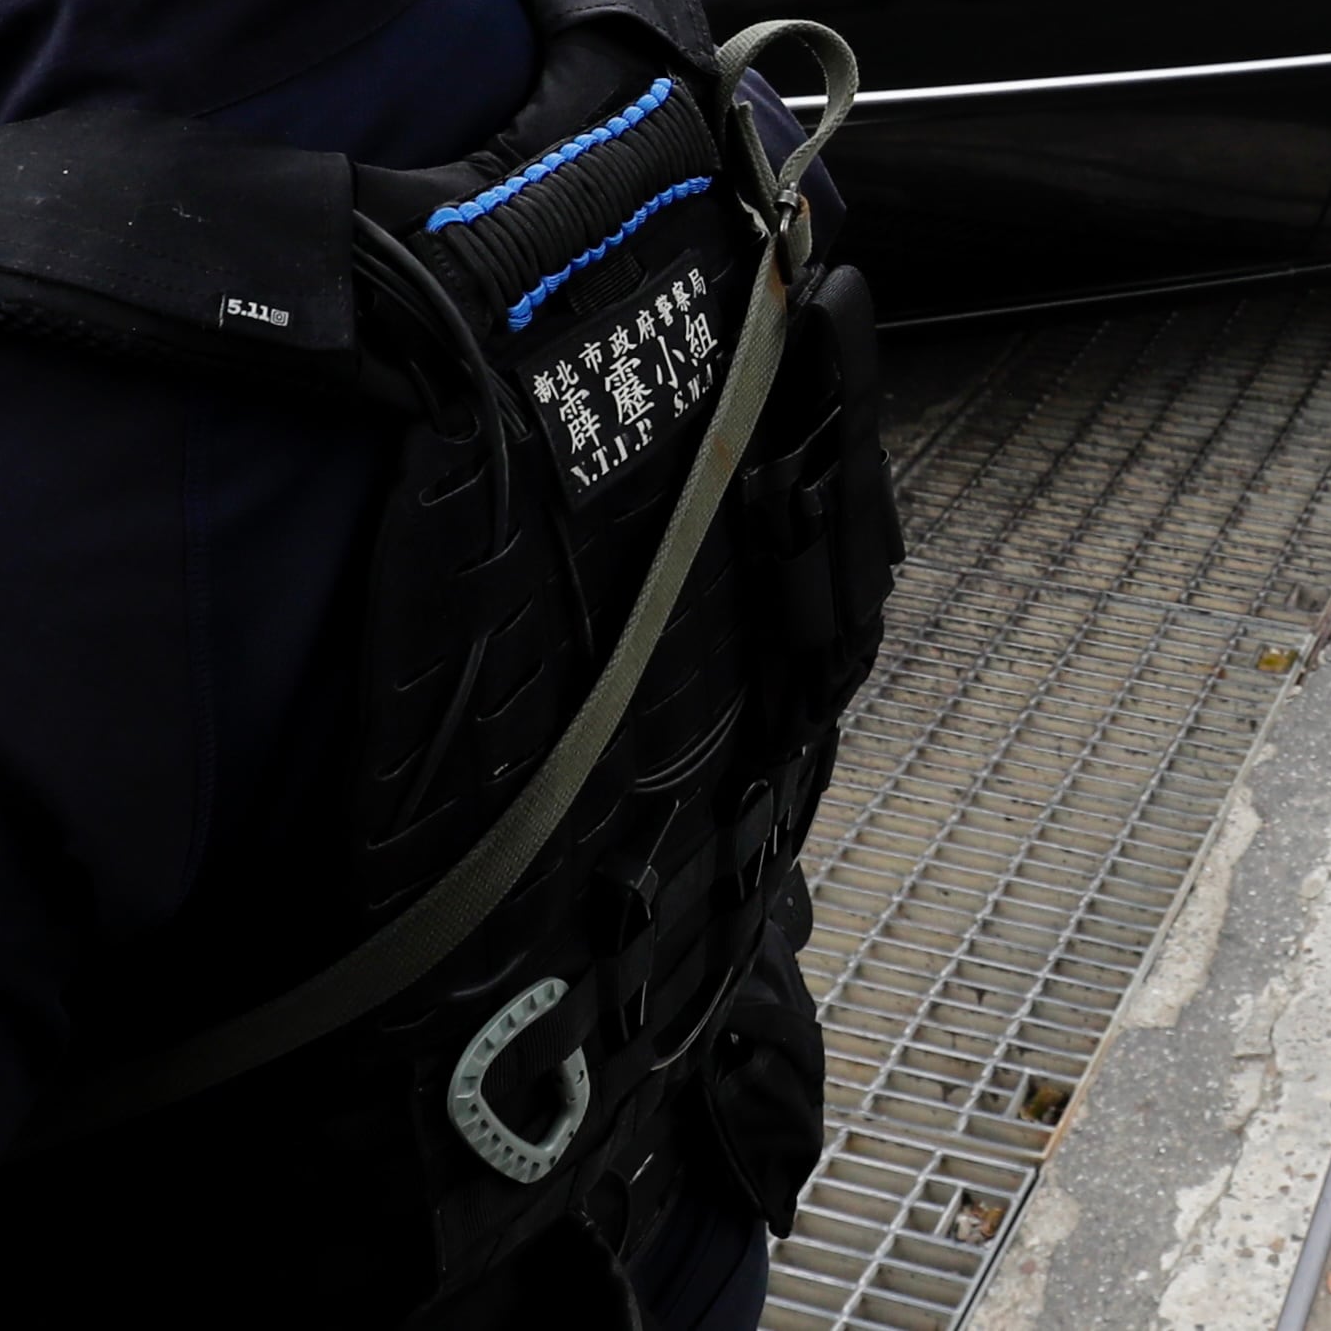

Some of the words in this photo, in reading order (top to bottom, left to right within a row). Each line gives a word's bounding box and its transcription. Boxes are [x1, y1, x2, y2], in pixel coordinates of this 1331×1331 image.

[226, 298, 271, 322] 5.11
[532, 267, 707, 405] 新北市政府警察局
[558, 311, 719, 455] 霹靂小組
